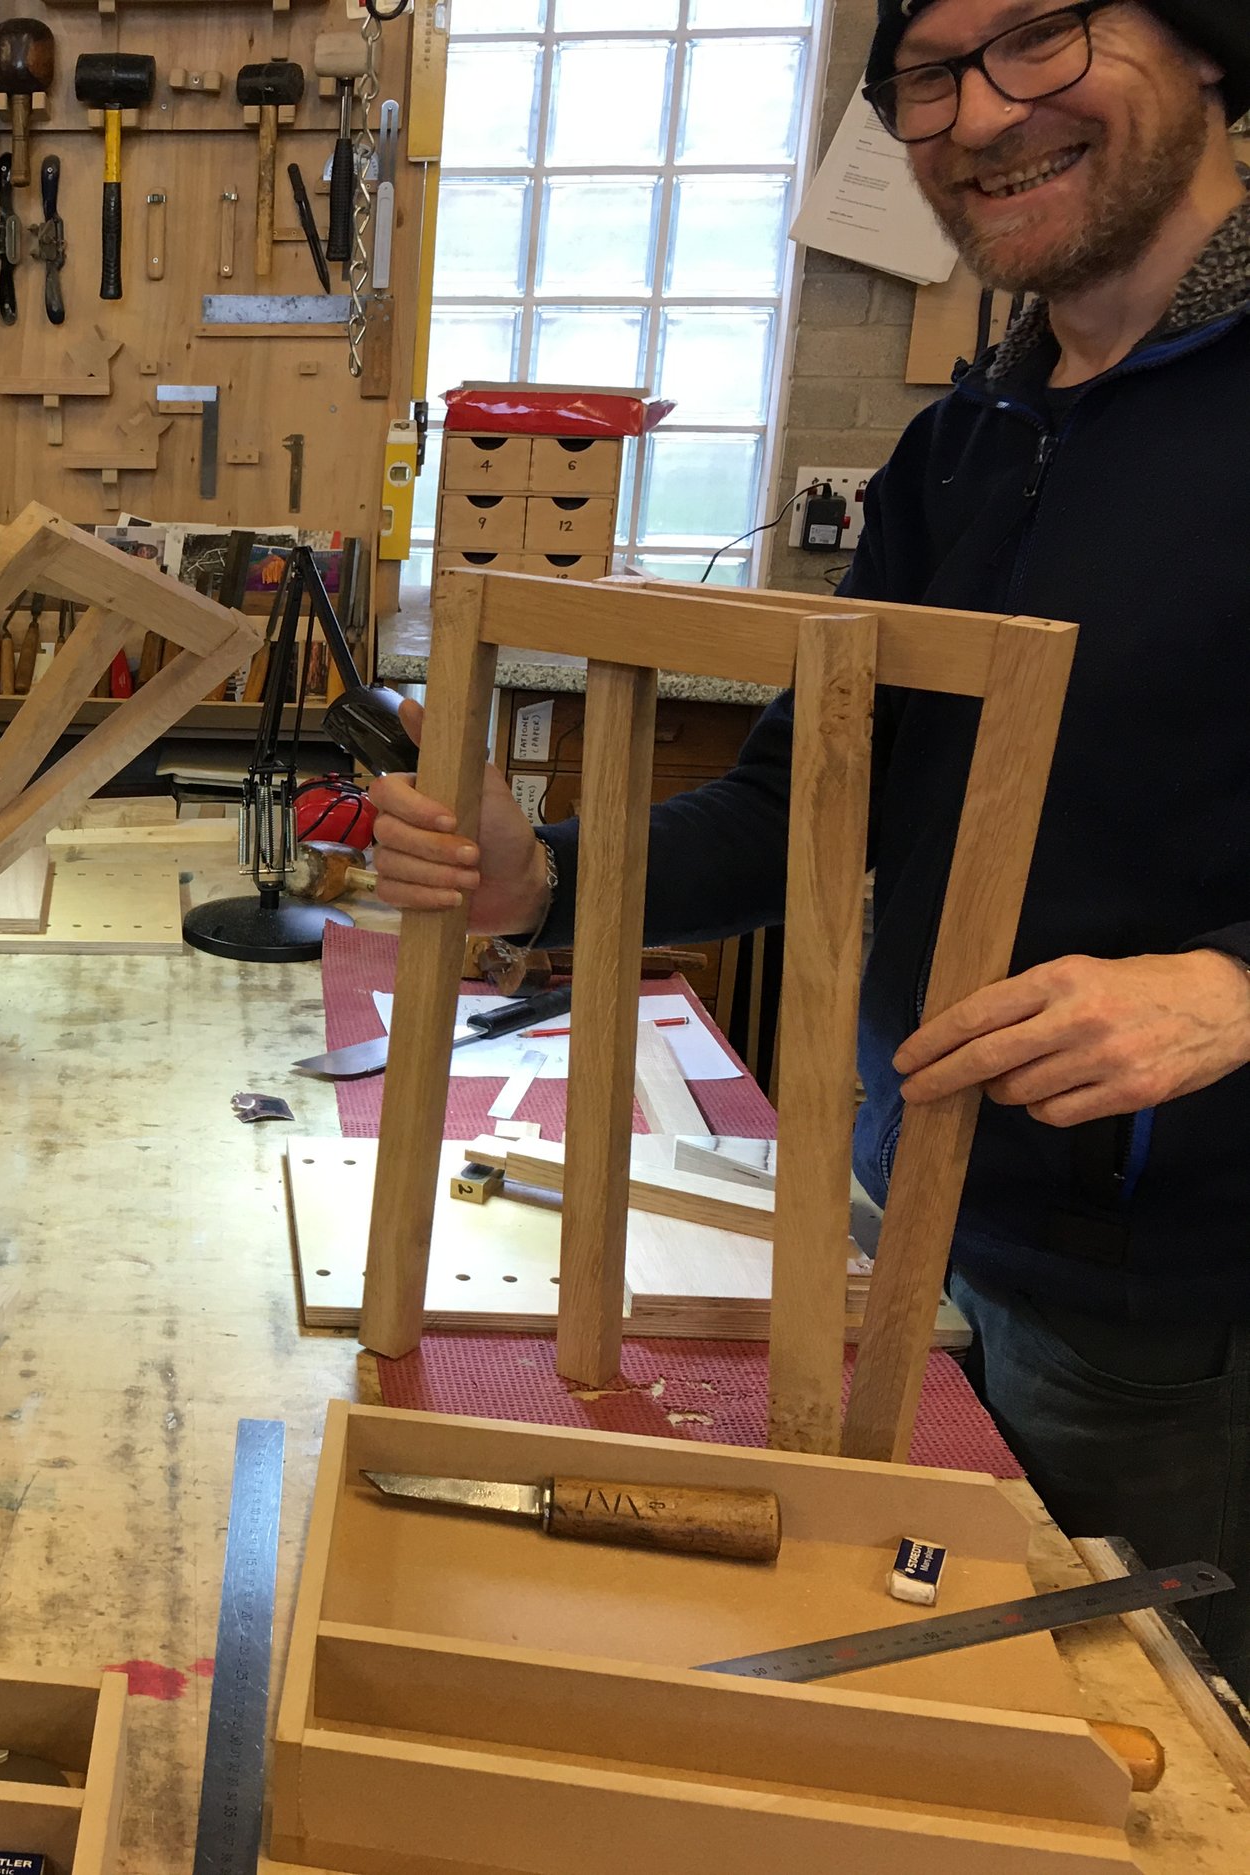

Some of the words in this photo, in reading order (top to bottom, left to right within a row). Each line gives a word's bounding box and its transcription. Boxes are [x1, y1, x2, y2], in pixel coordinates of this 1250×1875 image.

[480, 460, 493, 473] 4
[568, 460, 577, 471] 6
[478, 517, 487, 530] 9
[559, 520, 573, 532] 12
[458, 1183, 473, 1195] 2
[251, 1507, 261, 1515] 10
[246, 1558, 257, 1566] 15
[241, 1610, 253, 1621] 20
[236, 1670, 248, 1681] 25
[752, 1667, 768, 1676] 50
[224, 1805, 237, 1817] 35
